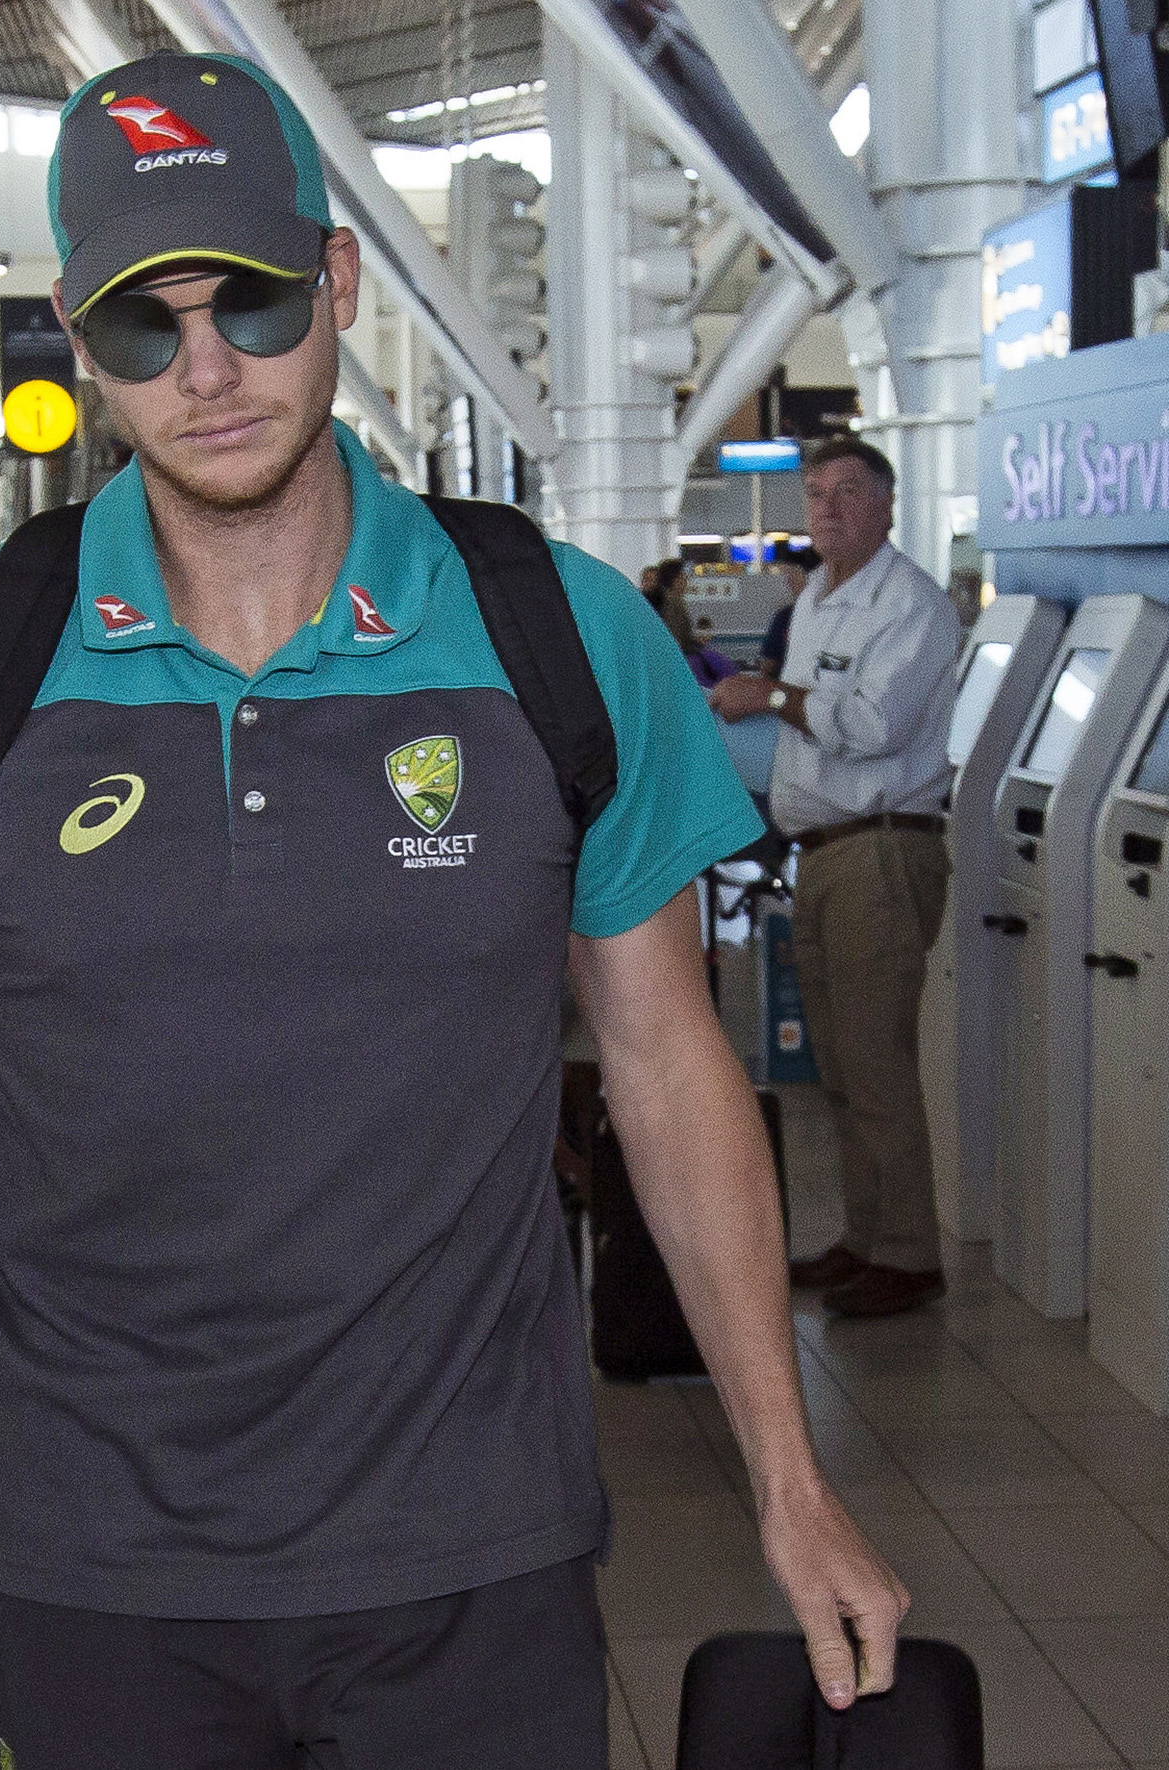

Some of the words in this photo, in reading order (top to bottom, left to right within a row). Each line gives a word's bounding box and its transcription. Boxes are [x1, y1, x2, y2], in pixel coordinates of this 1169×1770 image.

[134, 150, 227, 173] QANTAS
[1002, 421, 1066, 521] Self
[388, 834, 478, 856] CRICKET
[402, 856, 467, 868] AUSTRALIA
